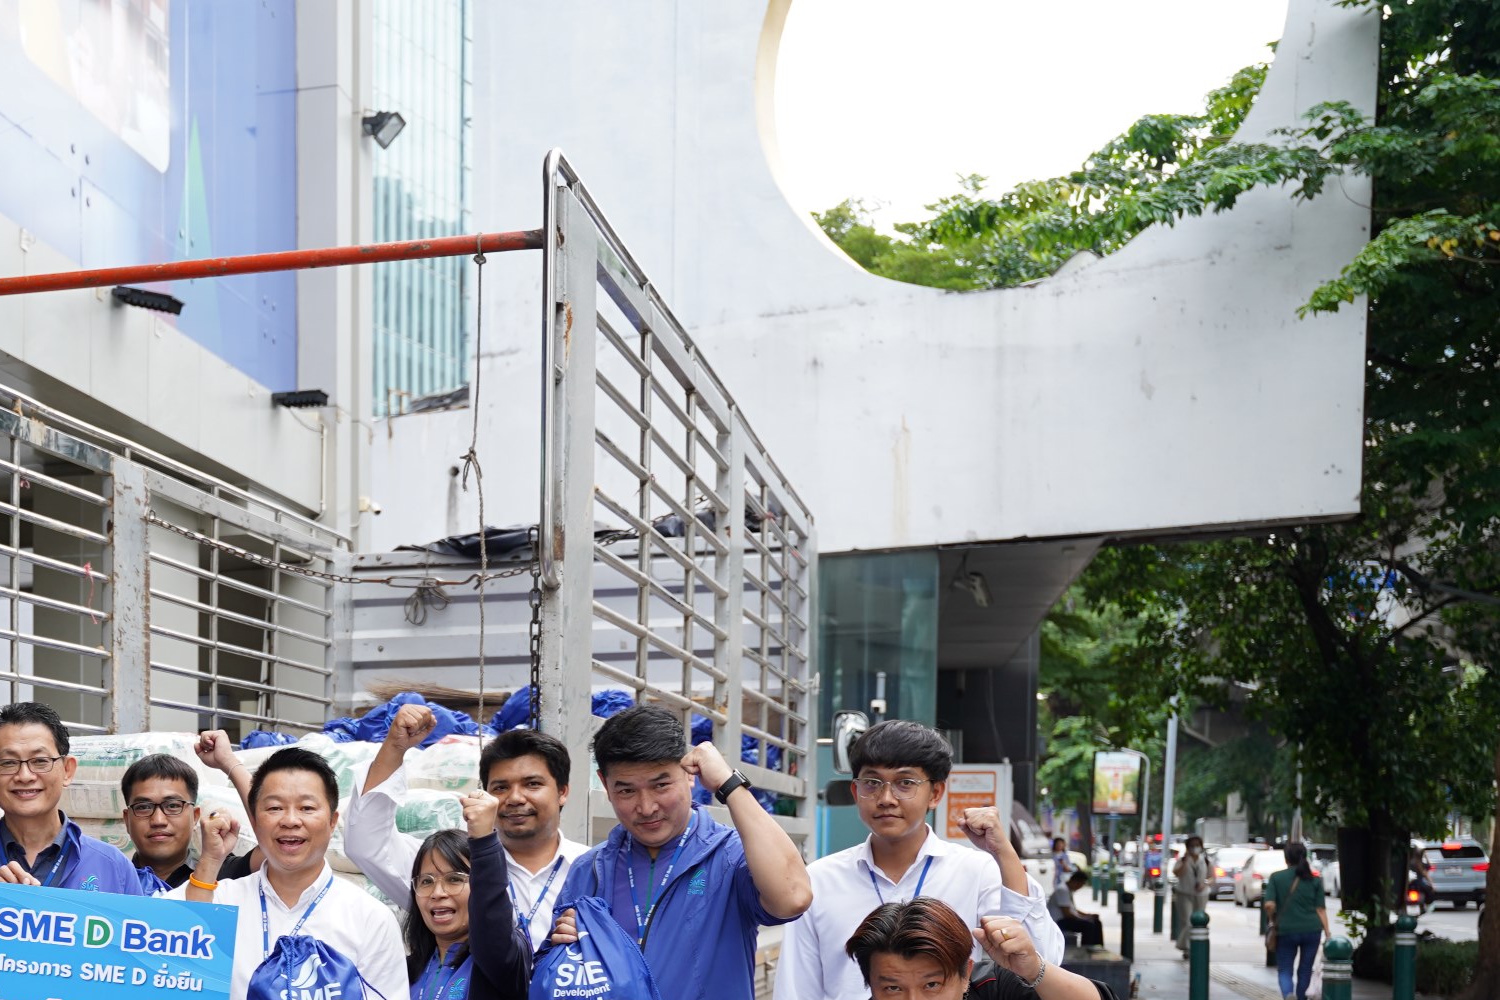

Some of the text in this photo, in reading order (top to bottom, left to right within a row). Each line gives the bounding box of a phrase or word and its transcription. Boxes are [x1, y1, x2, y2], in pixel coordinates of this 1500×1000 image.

[86, 917, 111, 946] D
[123, 922, 214, 957] Bank
[80, 962, 126, 984] SME
[132, 968, 147, 985] D
[153, 963, 204, 991] ยั่งยืน
